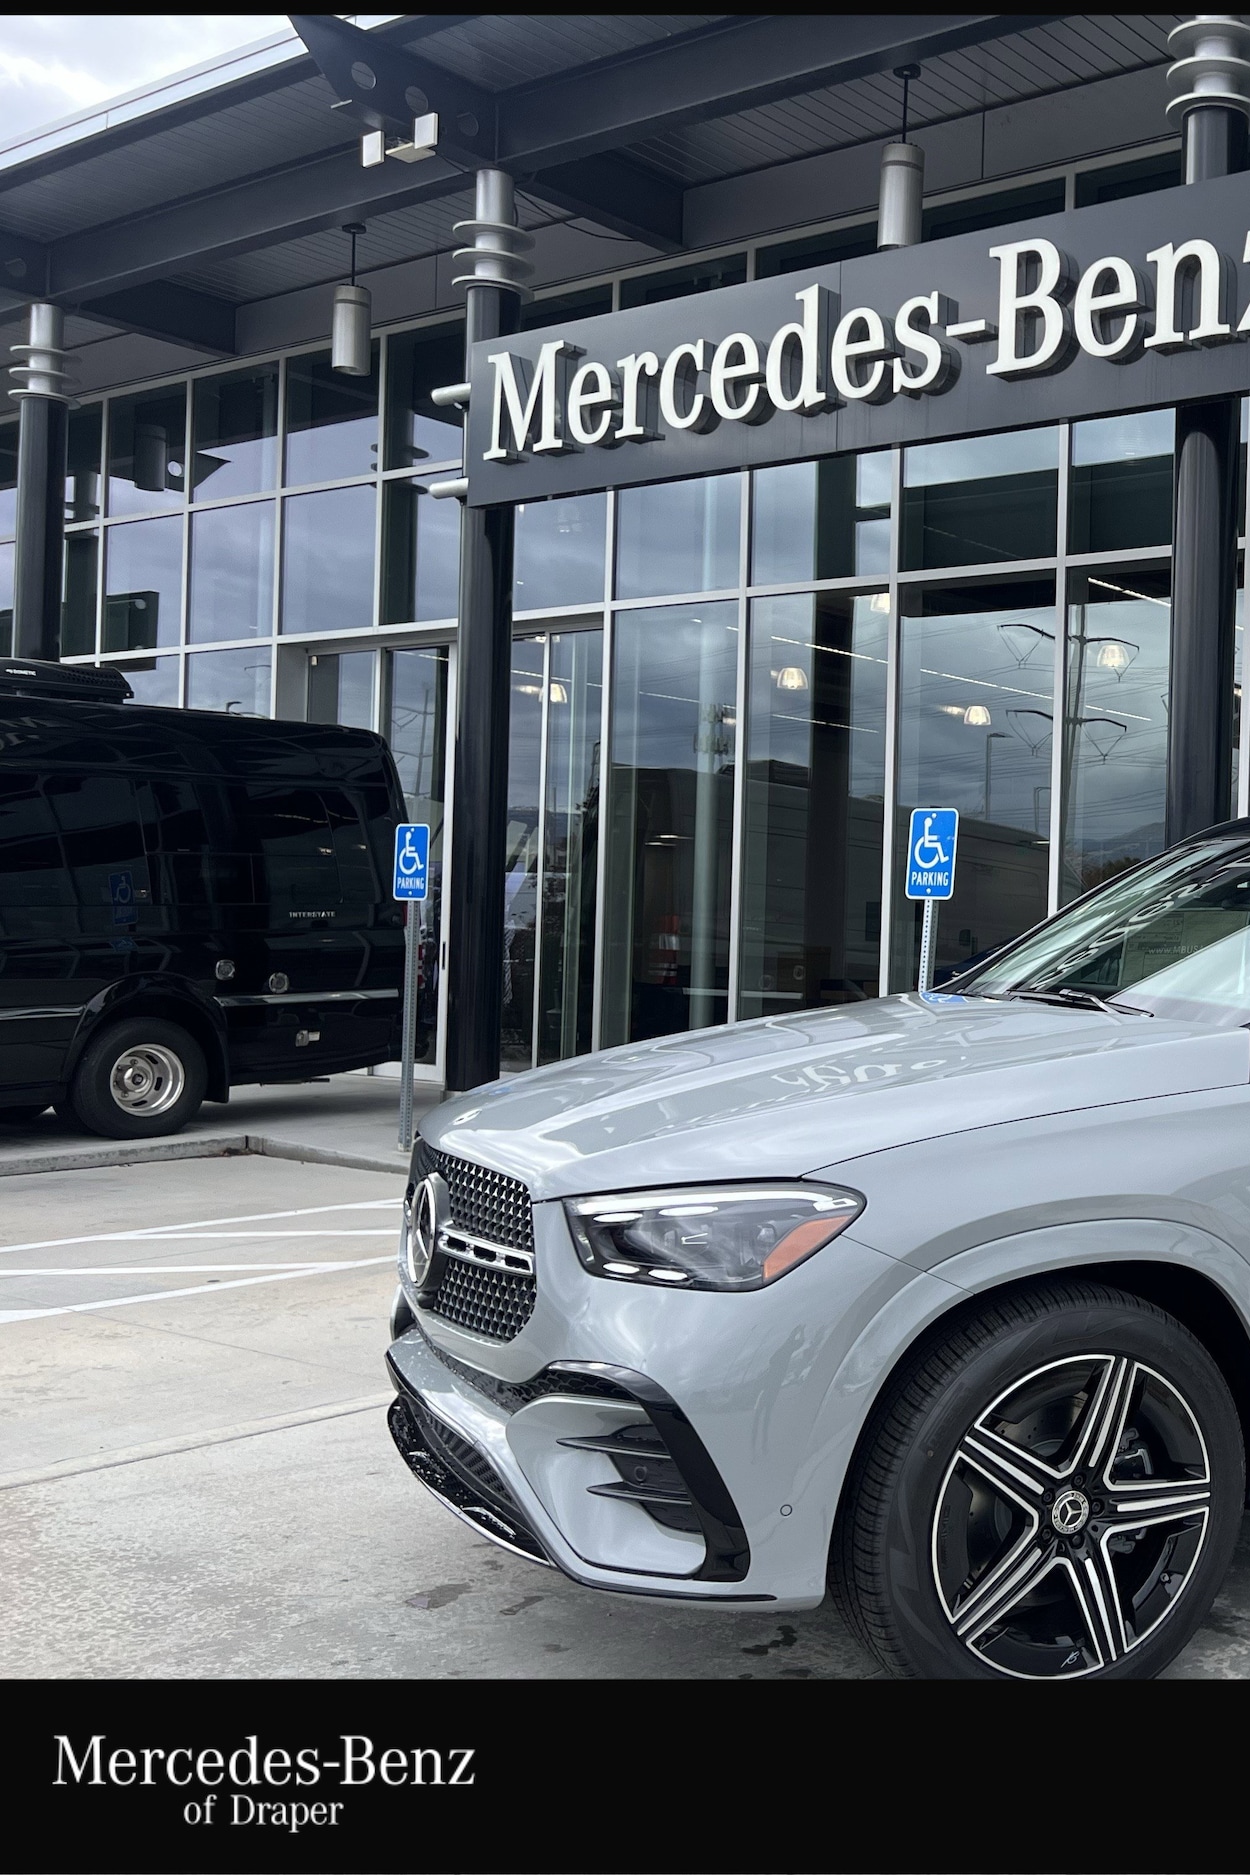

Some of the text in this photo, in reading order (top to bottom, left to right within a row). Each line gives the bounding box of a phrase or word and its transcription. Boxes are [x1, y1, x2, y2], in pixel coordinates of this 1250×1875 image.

[397, 877, 425, 890] PARKING
[911, 871, 949, 887] PARKING
[289, 911, 336, 919] INTERSTATE
